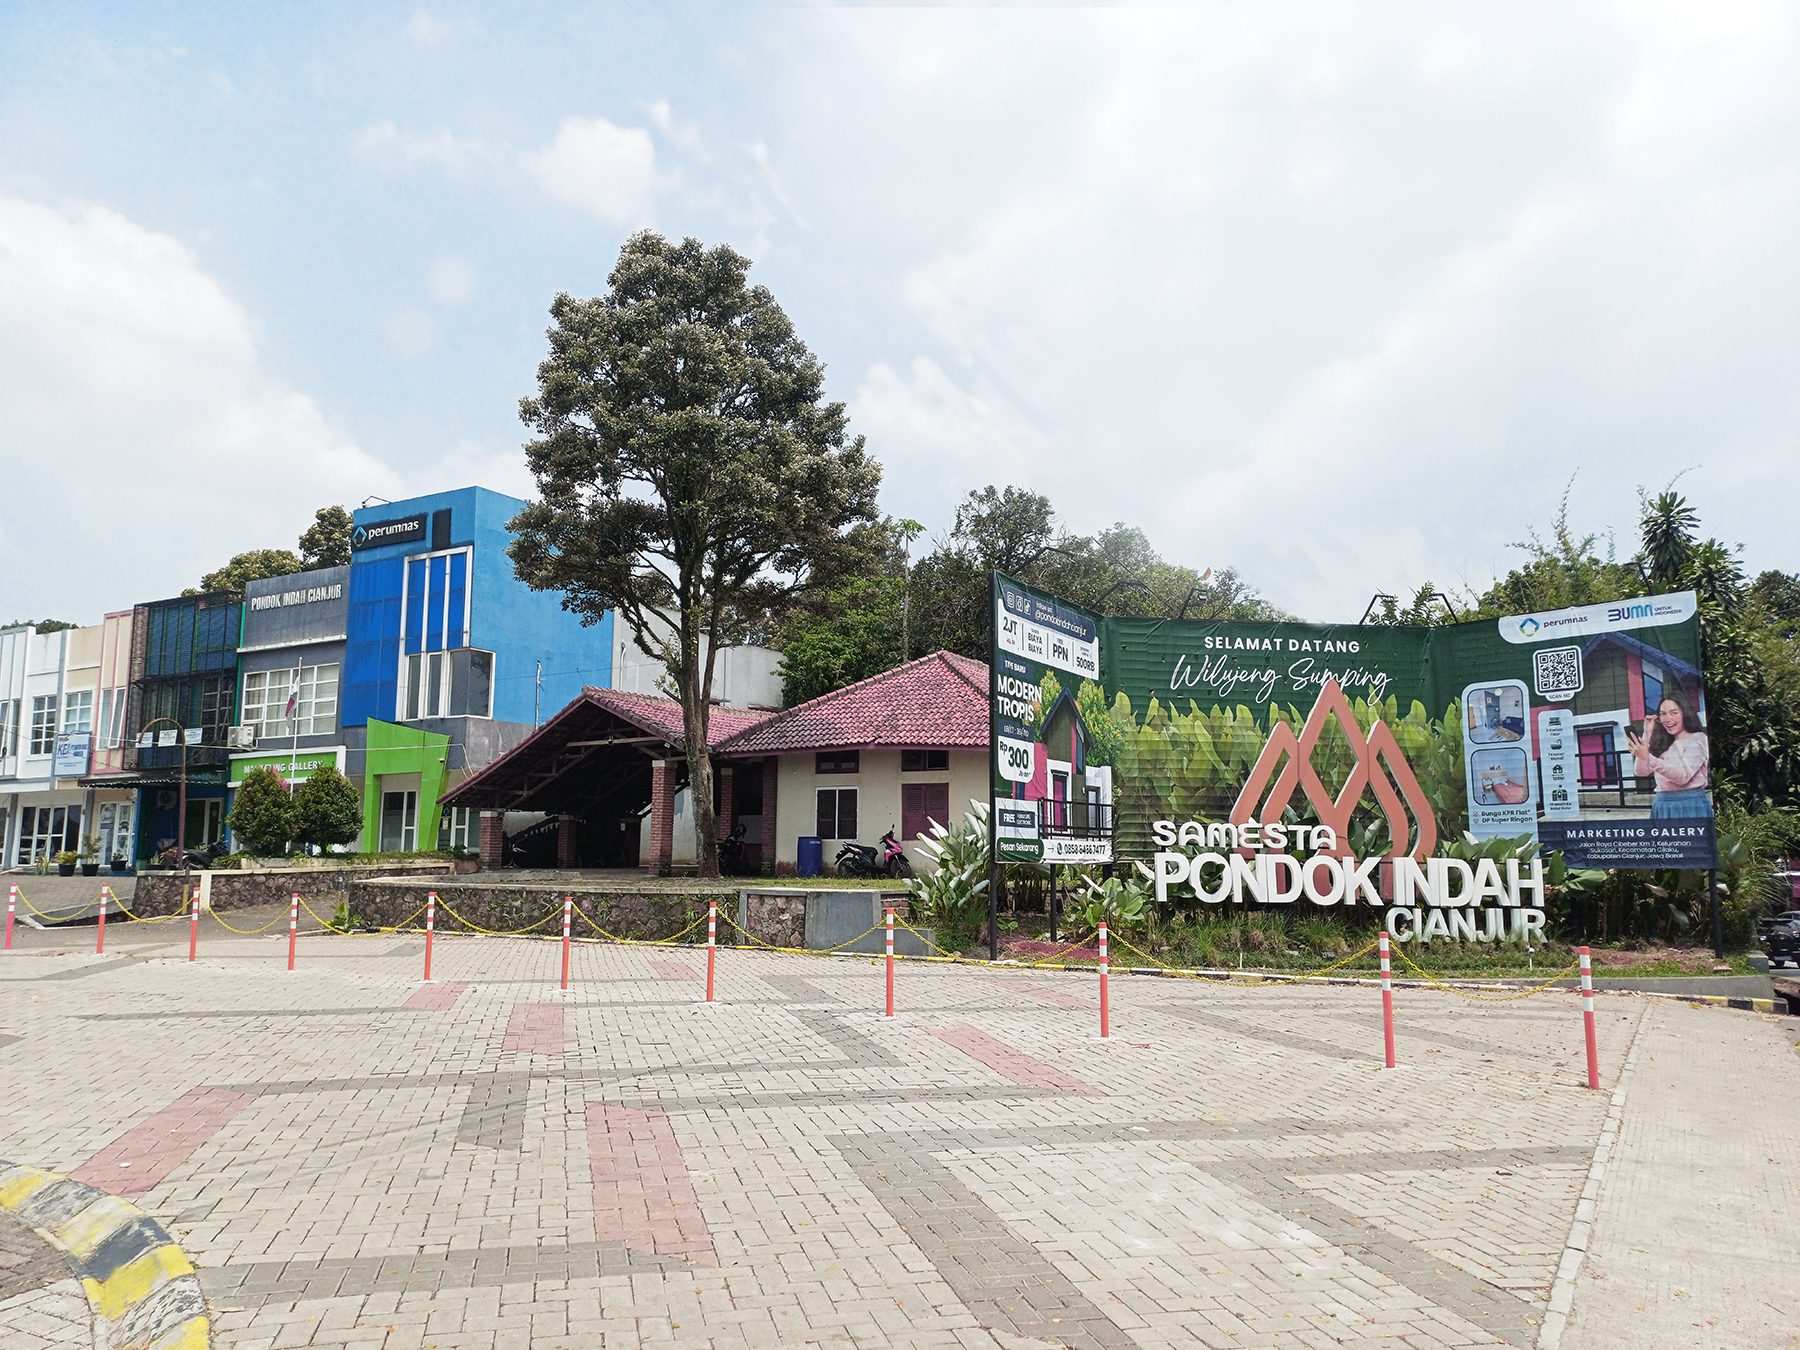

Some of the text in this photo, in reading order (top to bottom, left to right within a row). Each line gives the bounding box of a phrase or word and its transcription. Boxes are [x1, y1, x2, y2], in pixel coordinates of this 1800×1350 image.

[368, 519, 419, 540] perumnas
[251, 583, 342, 612] PONDOK INDAH CIANJUR
[1543, 615, 1588, 628] perumnas
[1608, 604, 1653, 622] BUMN
[1028, 632, 1043, 645] BIAYA
[1204, 636, 1360, 653] SELAMAT DATANG
[1028, 643, 1043, 655] BIAYA
[1053, 643, 1068, 662] PPN
[1076, 656, 1095, 672] 500RB
[997, 674, 1042, 704] MODERN
[1170, 654, 1393, 706] Wilujeng Sumping
[997, 696, 1035, 722] TROPIS
[999, 741, 1029, 769] Rp 300
[1003, 813, 1015, 823] FREE
[1151, 819, 1337, 851] SAMESTA
[1566, 827, 1705, 838] MARKETING GALERY
[1000, 841, 1039, 855] Pesan Sekarang
[1154, 852, 1545, 908] PONDOK INDAH
[1385, 906, 1548, 944] CIANJUR
